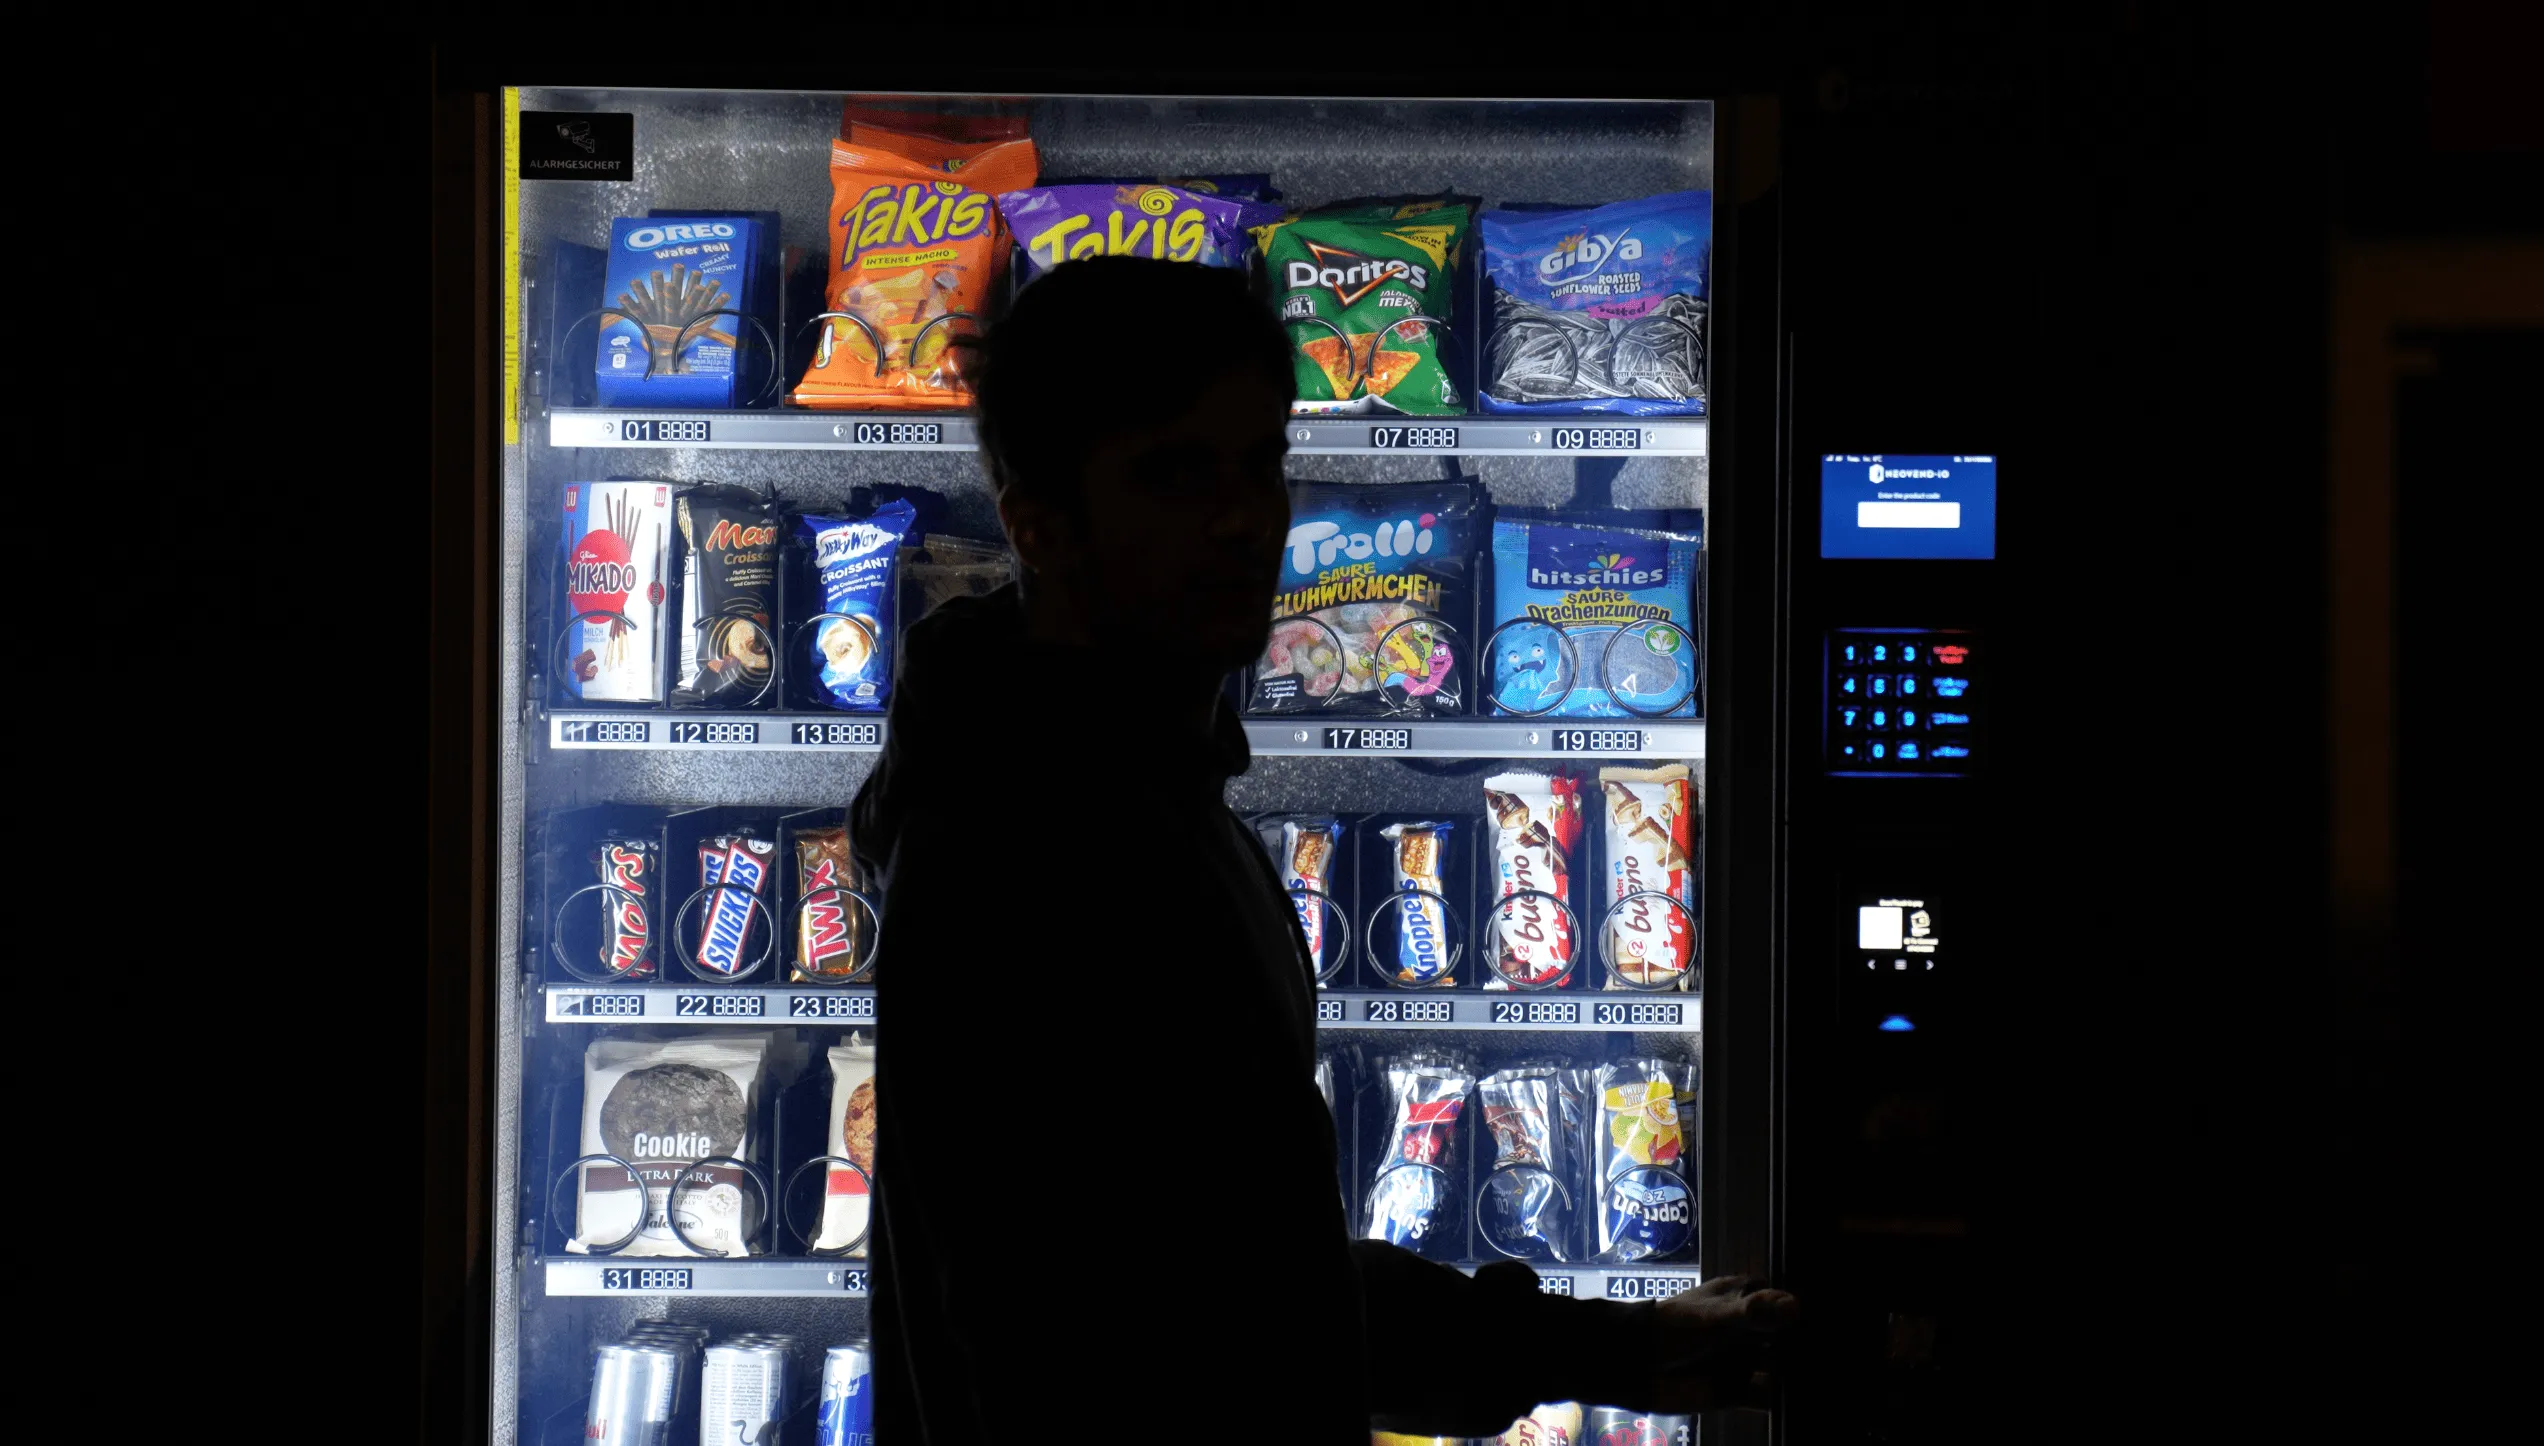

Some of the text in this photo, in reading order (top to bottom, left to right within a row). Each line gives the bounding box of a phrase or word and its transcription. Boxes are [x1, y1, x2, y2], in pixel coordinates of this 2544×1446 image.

[530, 159, 621, 170] ALARMGESICHERT
[843, 184, 989, 266] Takis
[628, 223, 734, 248] OREO
[1030, 208, 1205, 263] Takis
[654, 241, 730, 260] Wafer Roll
[866, 249, 950, 266] INTENSE NACHO
[1540, 227, 1643, 286] Gibya
[703, 263, 737, 275] MUNCHY
[1288, 259, 1427, 289] Doritos
[1598, 271, 1641, 285] ROASTED
[1550, 282, 1641, 300] SUNFLOWER SEEDS
[1282, 301, 1314, 321] NO.1
[625, 421, 650, 440] 01
[857, 424, 885, 443] 03
[1374, 428, 1402, 447] 07
[1556, 429, 1584, 449] 09
[1893, 492, 1903, 500] the
[705, 519, 778, 552] Mar
[1284, 513, 1436, 575] Trolli
[565, 560, 637, 595] MIKADO
[820, 557, 889, 585] CROISSANT
[1318, 561, 1376, 586] SAURE
[1531, 567, 1664, 585] hitschies
[1527, 603, 1671, 623] Drachenzungen
[584, 627, 604, 637] MILCH
[1845, 645, 1855, 661] 1
[1874, 645, 1886, 661] 2
[1904, 646, 1916, 662] 3
[1843, 677, 1856, 693] 4
[1844, 710, 1856, 726] 7
[675, 723, 701, 742] 12
[797, 724, 822, 744] 13
[1328, 729, 1355, 748] 17
[1558, 731, 1585, 750] 19
[1872, 743, 1885, 758] 0
[1513, 854, 1545, 942] bueno
[1624, 855, 1652, 933] bueno
[611, 846, 655, 978] Mars
[805, 859, 851, 971] TWIX
[1399, 878, 1440, 982] Knoppers
[679, 997, 708, 1015] 22
[793, 997, 820, 1016] 23
[1369, 1002, 1398, 1020] 28
[1495, 1004, 1524, 1022] 29
[1598, 1005, 1626, 1023] 30
[633, 1132, 711, 1158] Cookie
[607, 1270, 631, 1288] 31
[1610, 1279, 1639, 1297] 40
